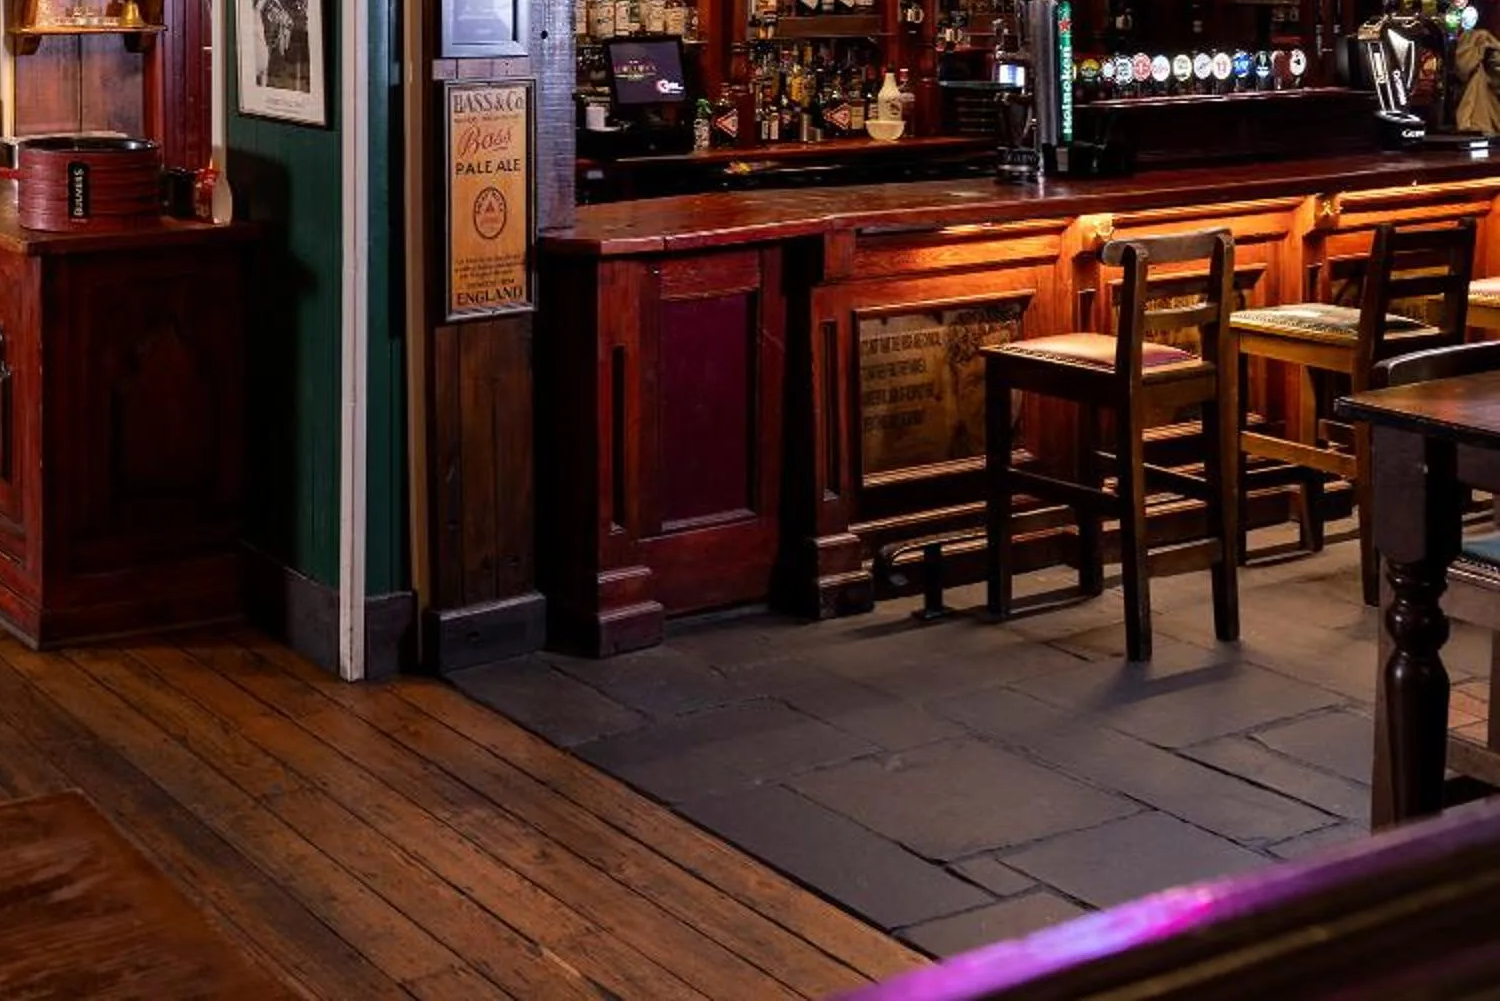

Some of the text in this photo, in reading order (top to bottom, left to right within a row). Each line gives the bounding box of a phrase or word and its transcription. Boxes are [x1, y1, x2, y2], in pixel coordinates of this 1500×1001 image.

[1060, 44, 1073, 135] Heineken
[458, 125, 513, 158] Bass
[455, 158, 521, 176] PALE ALE
[457, 286, 523, 306] ENGLAND
